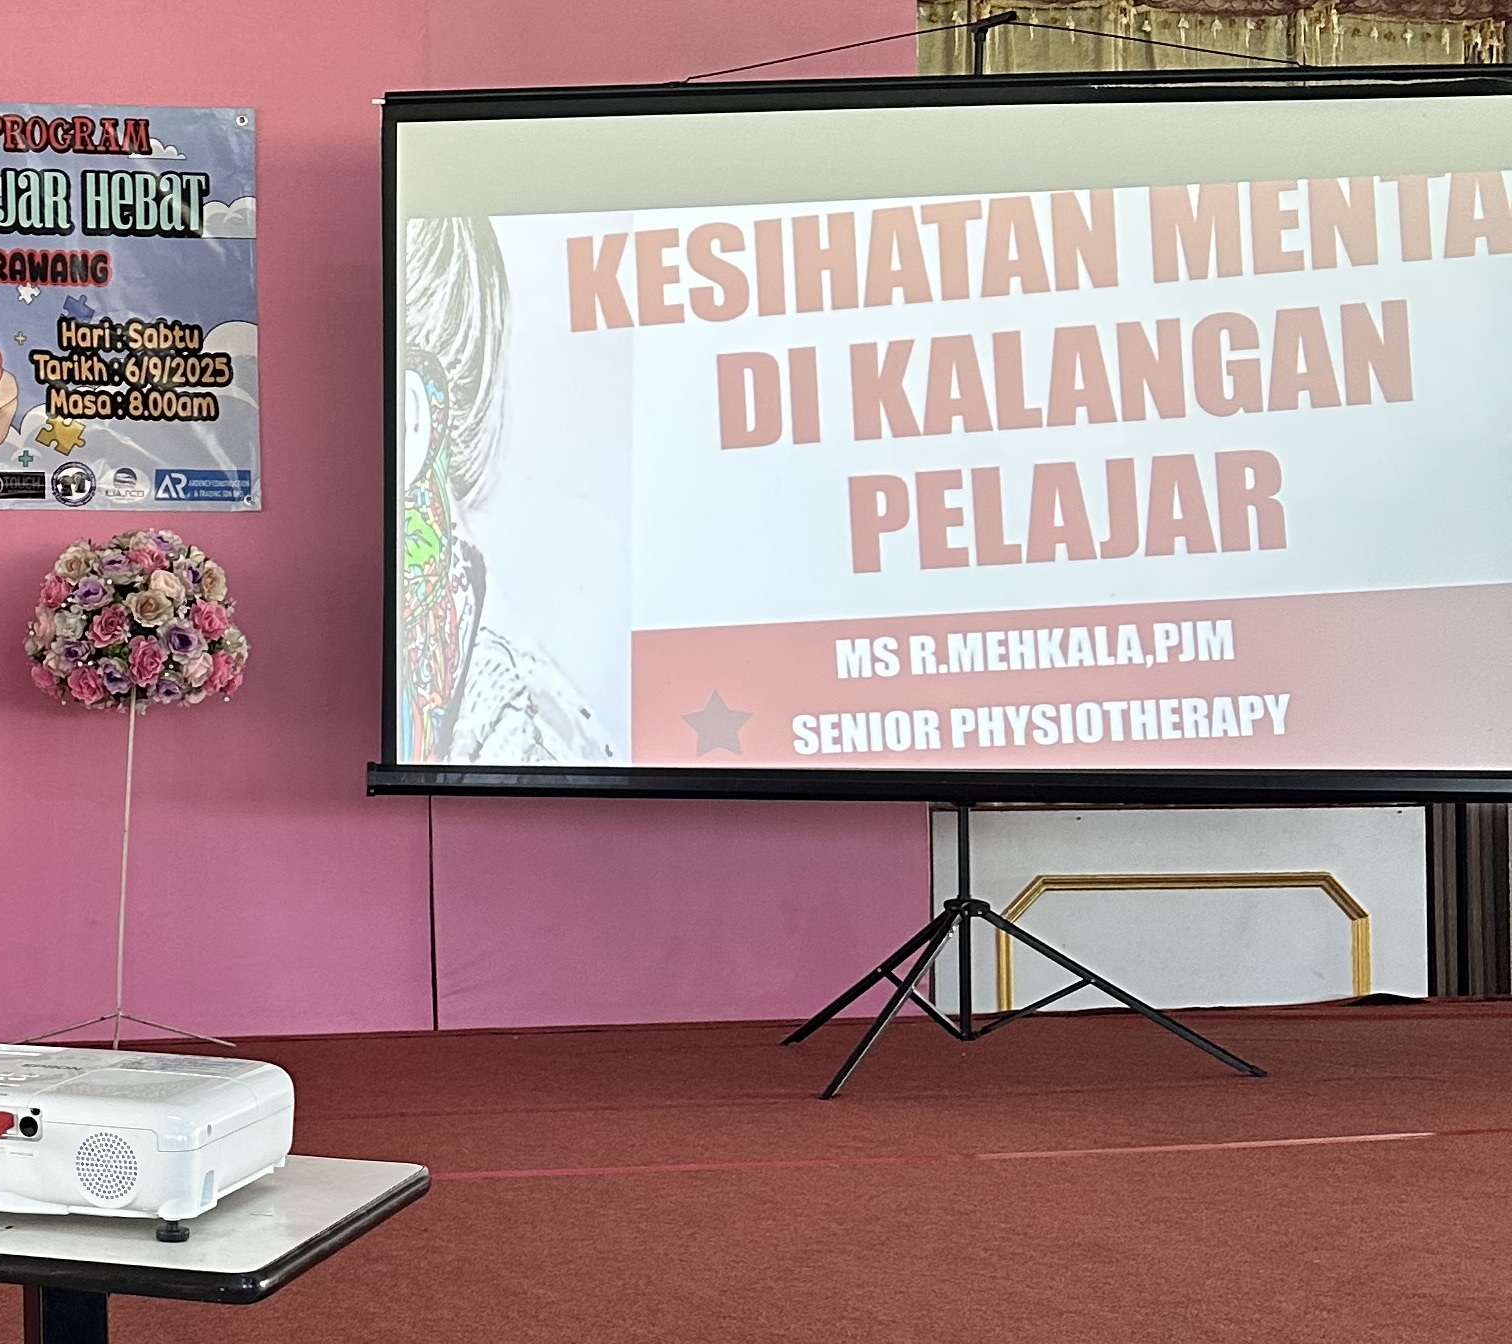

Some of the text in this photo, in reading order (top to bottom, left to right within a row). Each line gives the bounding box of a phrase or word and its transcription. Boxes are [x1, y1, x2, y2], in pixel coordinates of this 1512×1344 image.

[567, 188, 1119, 332] KESIHATAN
[61, 320, 110, 348] Hari
[128, 322, 199, 350] Sabtu
[33, 353, 108, 382] Tarikh
[125, 356, 230, 384] 6/9/2025
[716, 298, 1414, 450] DI KALANGAN
[50, 389, 112, 416] Masa
[128, 390, 215, 417] 8.00am
[848, 450, 1287, 573] PELAJAR
[835, 620, 1234, 679] MS R.MEHKALA,PJM
[792, 693, 1290, 755] SENIOR PHYSIOTHERAPY
